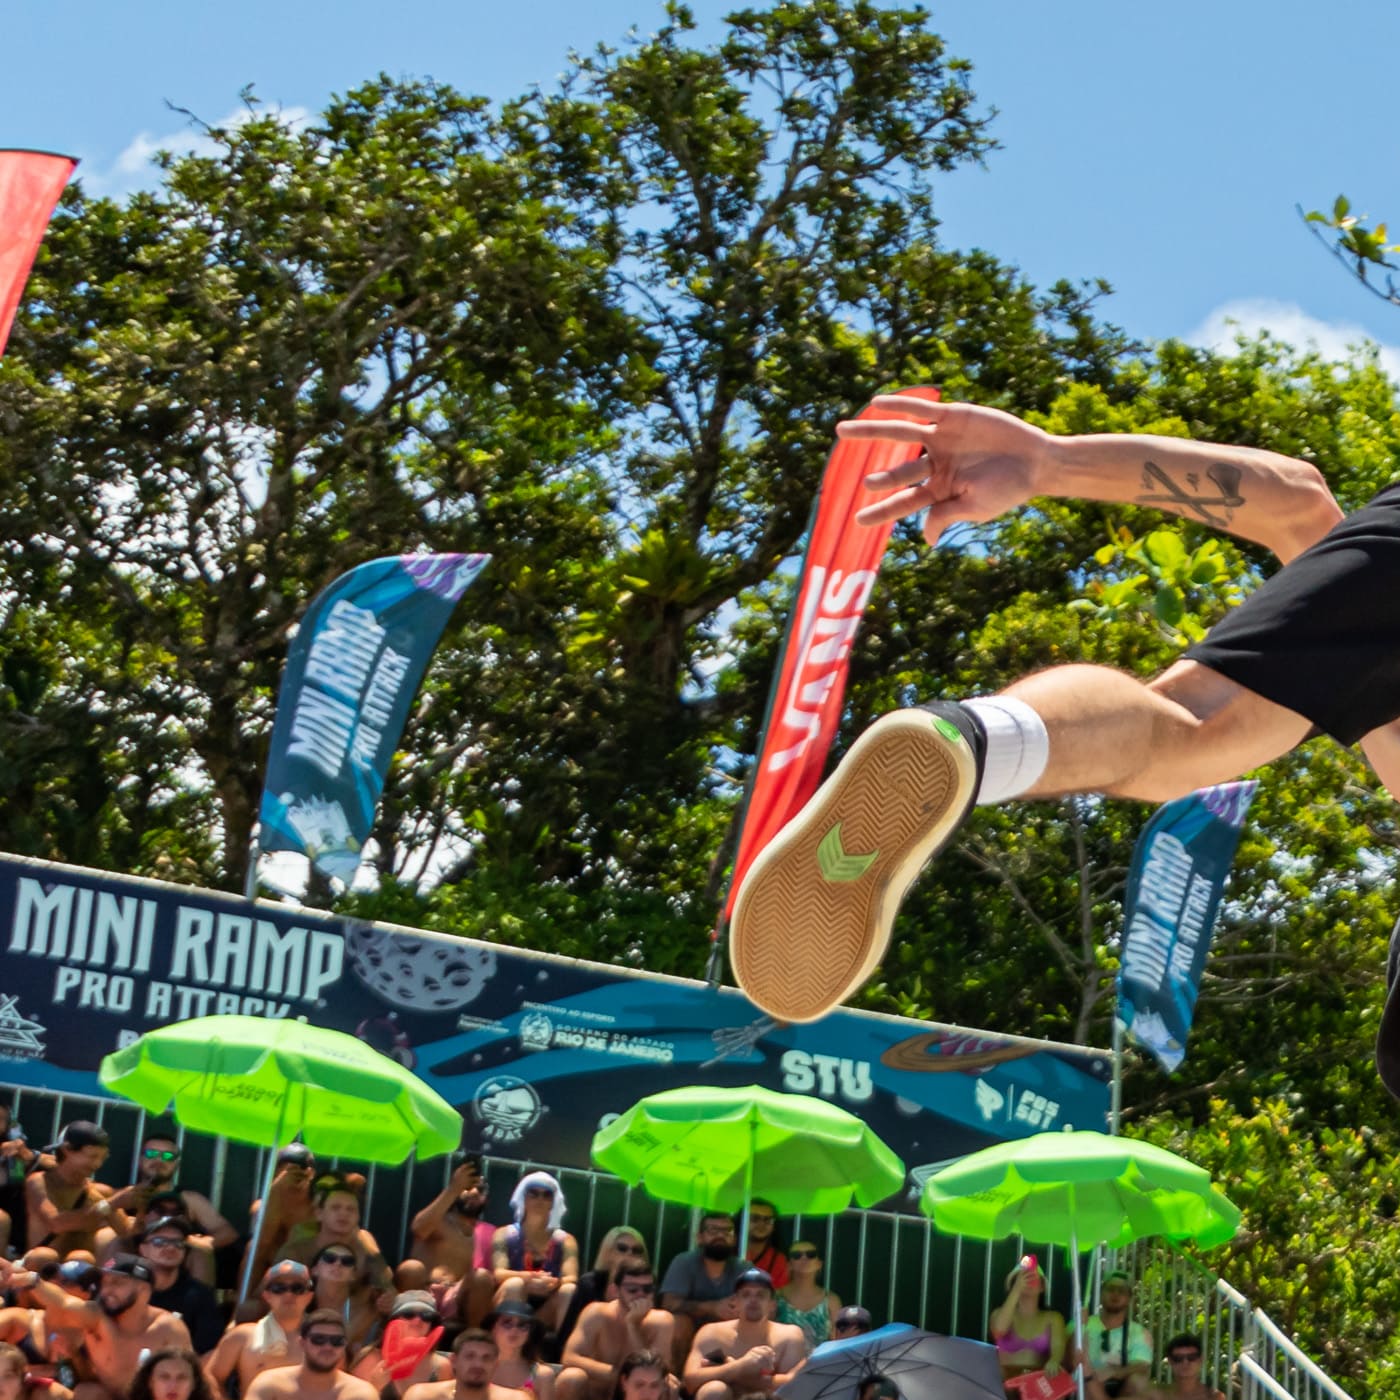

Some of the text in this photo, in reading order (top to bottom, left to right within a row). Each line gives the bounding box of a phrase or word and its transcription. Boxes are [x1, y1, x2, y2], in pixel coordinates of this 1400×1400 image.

[286, 599, 386, 777] MINI RAMP
[351, 646, 411, 771] PRO ATTACK
[768, 565, 877, 771] VANS
[8, 876, 345, 1001] MINI RAMP
[1124, 831, 1194, 991] MINI RAMP
[1169, 872, 1213, 983] PRO ATTACK
[54, 966, 133, 1017] PRO
[554, 1031, 674, 1063] RIO DE JANEIRO
[555, 1024, 609, 1039] GOVERNO
[631, 1036, 675, 1050] ESTADO
[781, 1049, 874, 1100] STU
